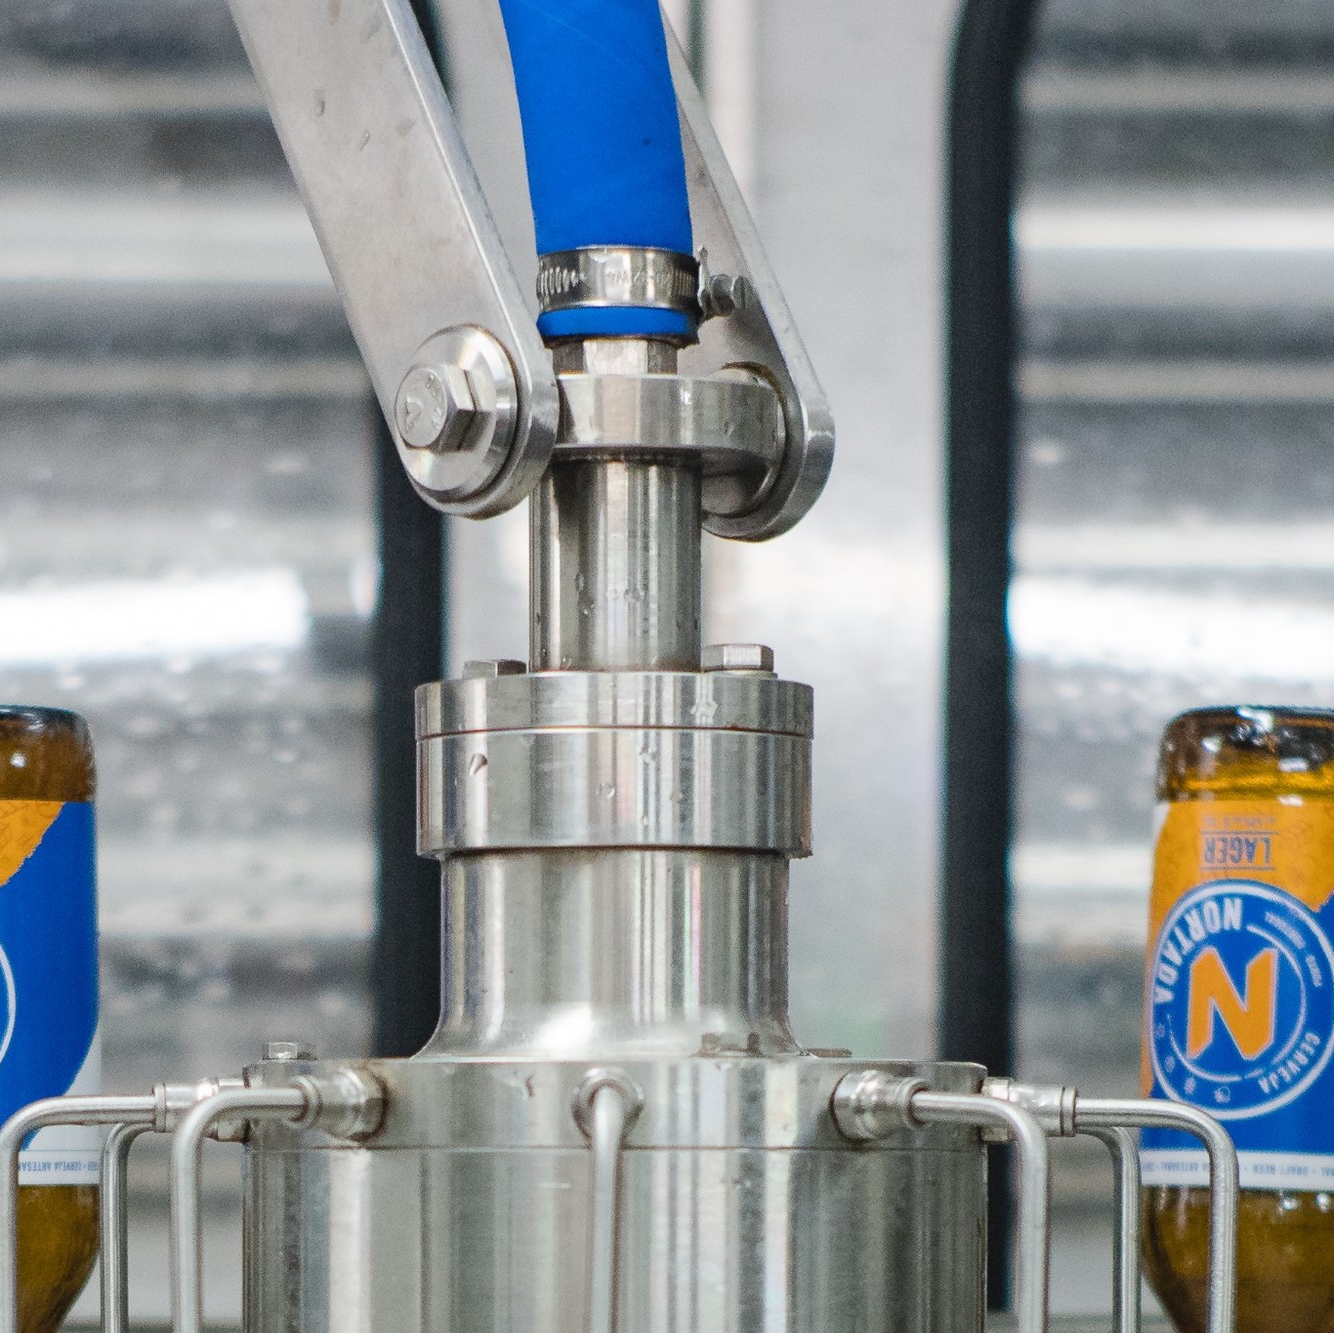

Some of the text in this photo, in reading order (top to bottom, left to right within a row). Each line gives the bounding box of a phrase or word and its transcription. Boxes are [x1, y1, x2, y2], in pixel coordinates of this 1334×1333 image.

[1204, 837, 1271, 864] LAGER
[1153, 897, 1242, 1004] NORTADA
[1186, 946, 1280, 1062] N
[1257, 1031, 1321, 1095] CERVEJA
